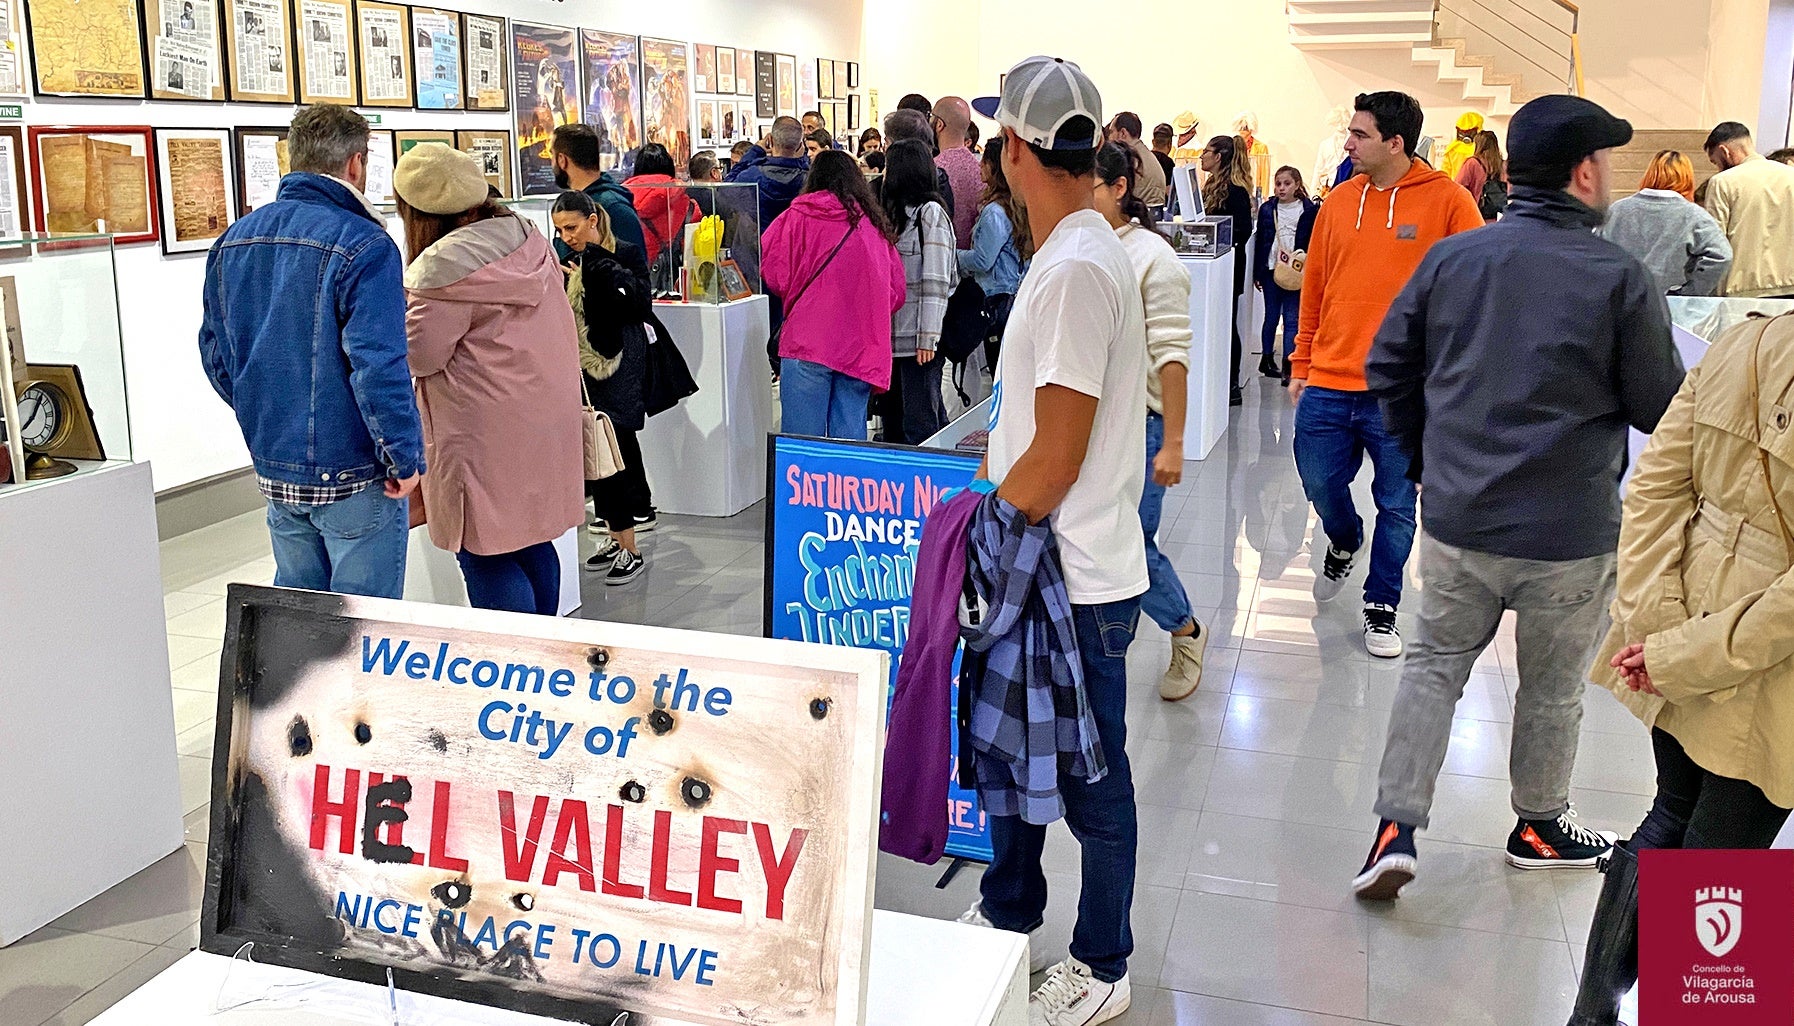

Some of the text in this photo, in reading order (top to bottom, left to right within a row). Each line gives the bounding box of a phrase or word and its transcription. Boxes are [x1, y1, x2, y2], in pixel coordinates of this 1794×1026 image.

[786, 464, 905, 517] SATURDAY
[824, 511, 920, 546] DANCE
[361, 635, 733, 717] Welcome to the
[477, 700, 642, 760] City of
[497, 789, 810, 921] VALLEY
[335, 891, 719, 987] NICE PLACE TO LIVE
